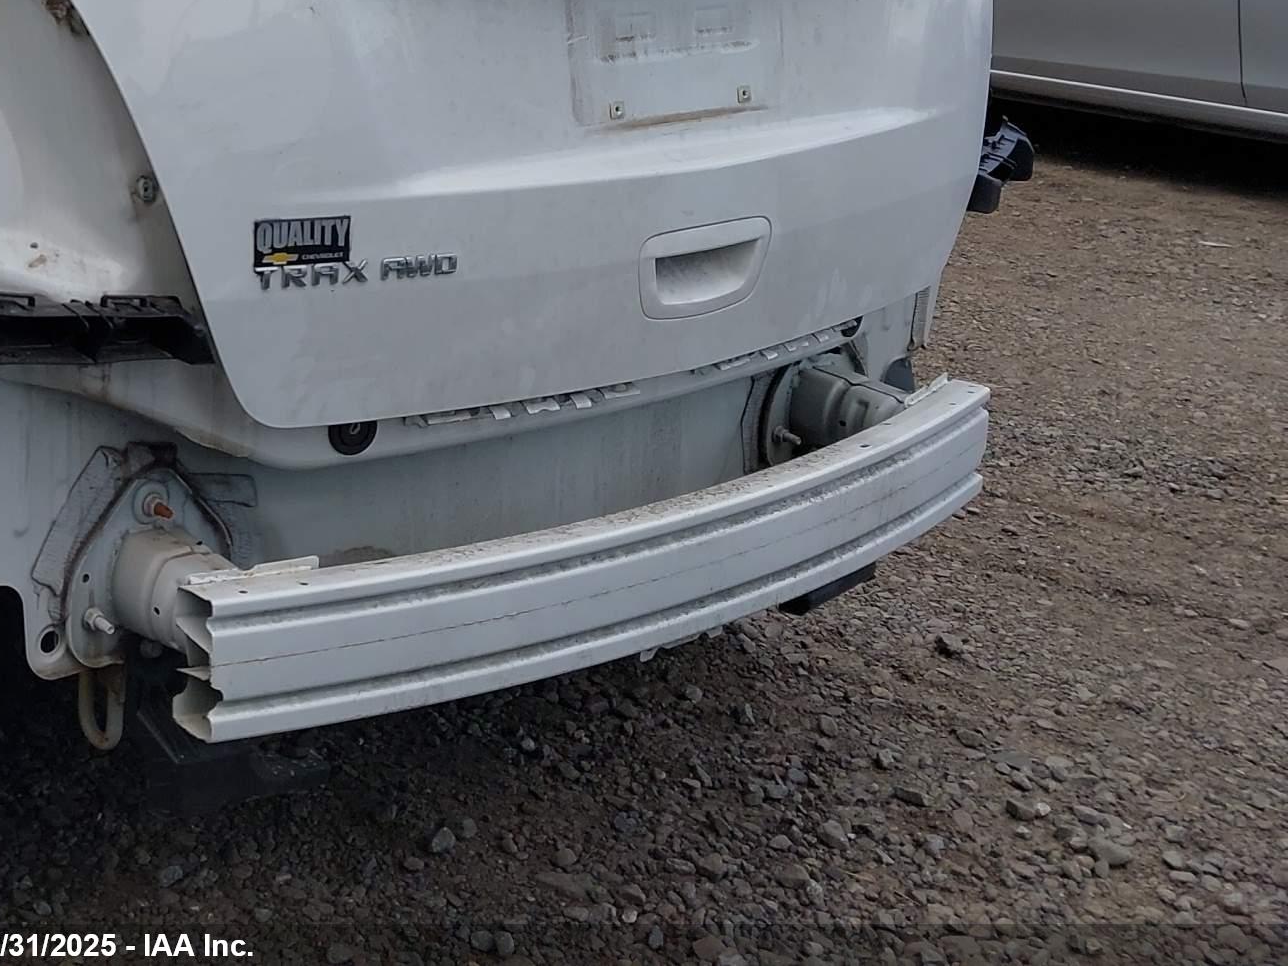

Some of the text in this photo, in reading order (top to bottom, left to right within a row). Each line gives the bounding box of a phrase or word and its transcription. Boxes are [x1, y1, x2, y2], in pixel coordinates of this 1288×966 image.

[256, 218, 349, 253] QUALITY
[253, 253, 458, 291] TRAX AWD
